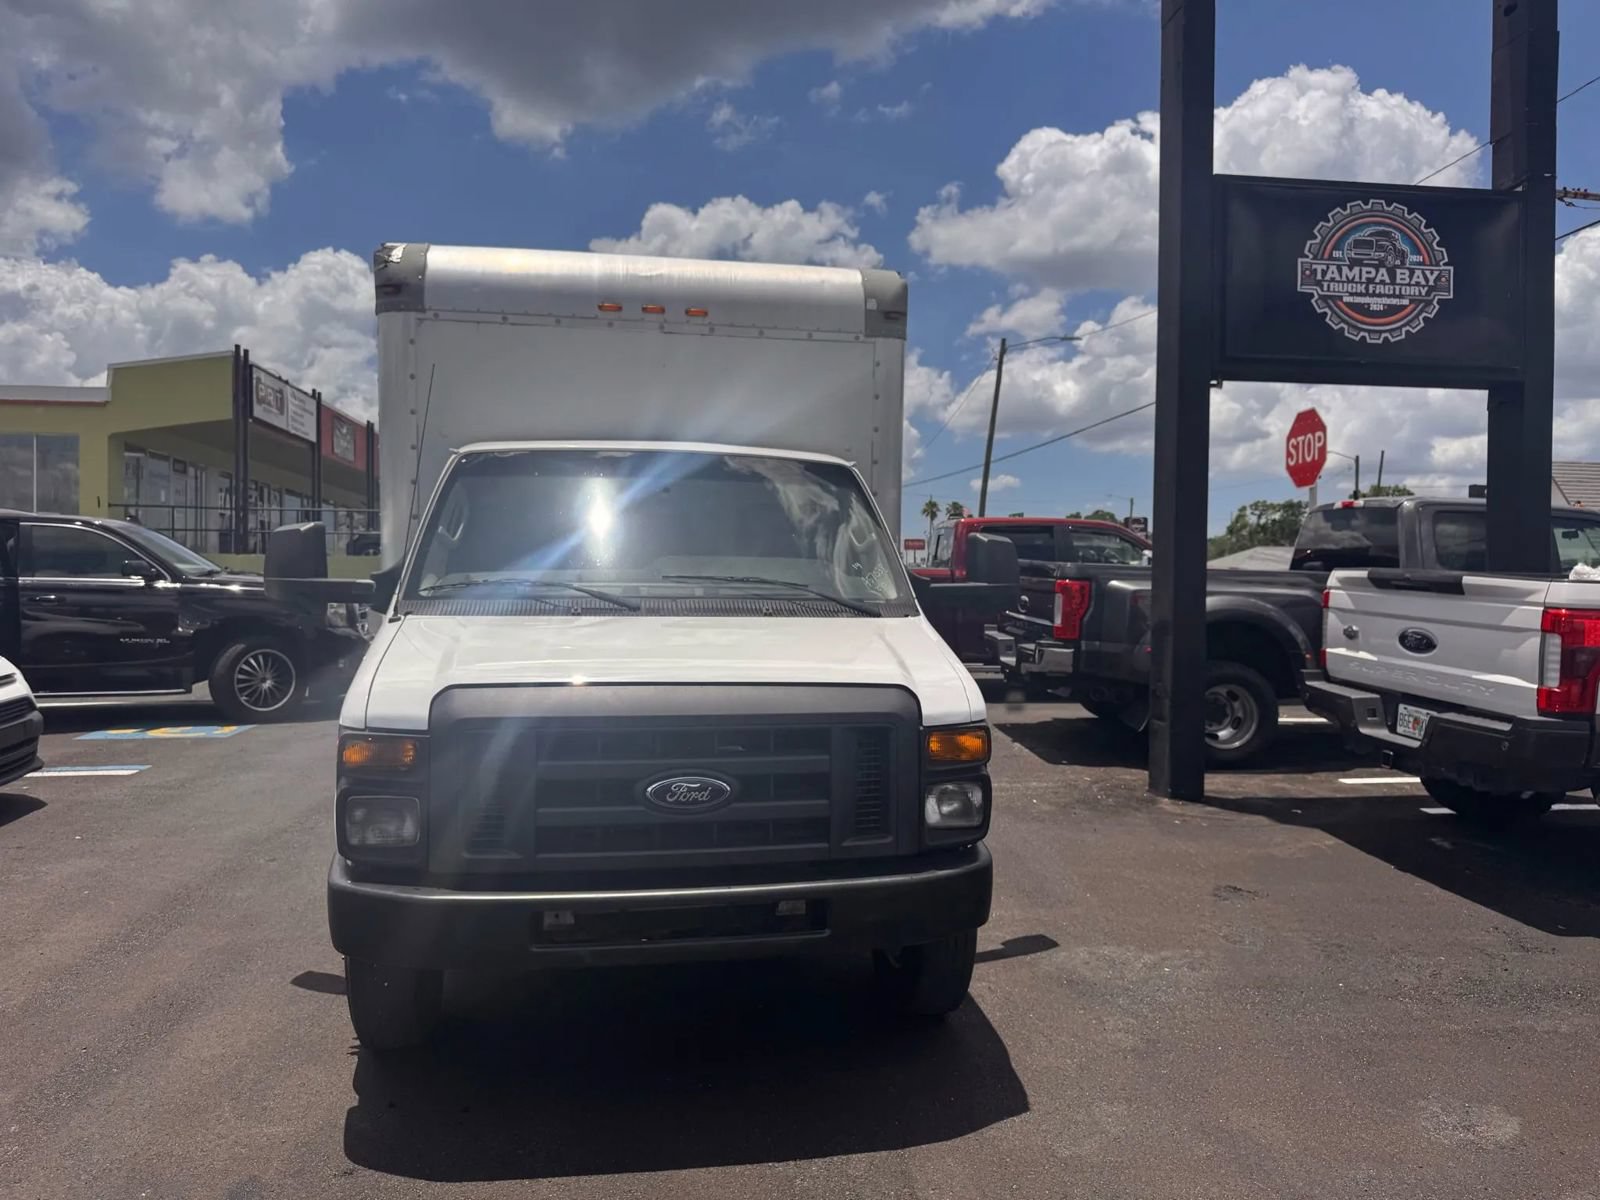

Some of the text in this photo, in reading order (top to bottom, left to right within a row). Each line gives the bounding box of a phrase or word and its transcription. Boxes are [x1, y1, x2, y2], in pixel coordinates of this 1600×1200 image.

[1312, 264, 1440, 286] TAMPA BAY
[1322, 281, 1429, 296] TRUCK FACTORY
[1287, 431, 1324, 466] STOP
[666, 782, 712, 802] Ford
